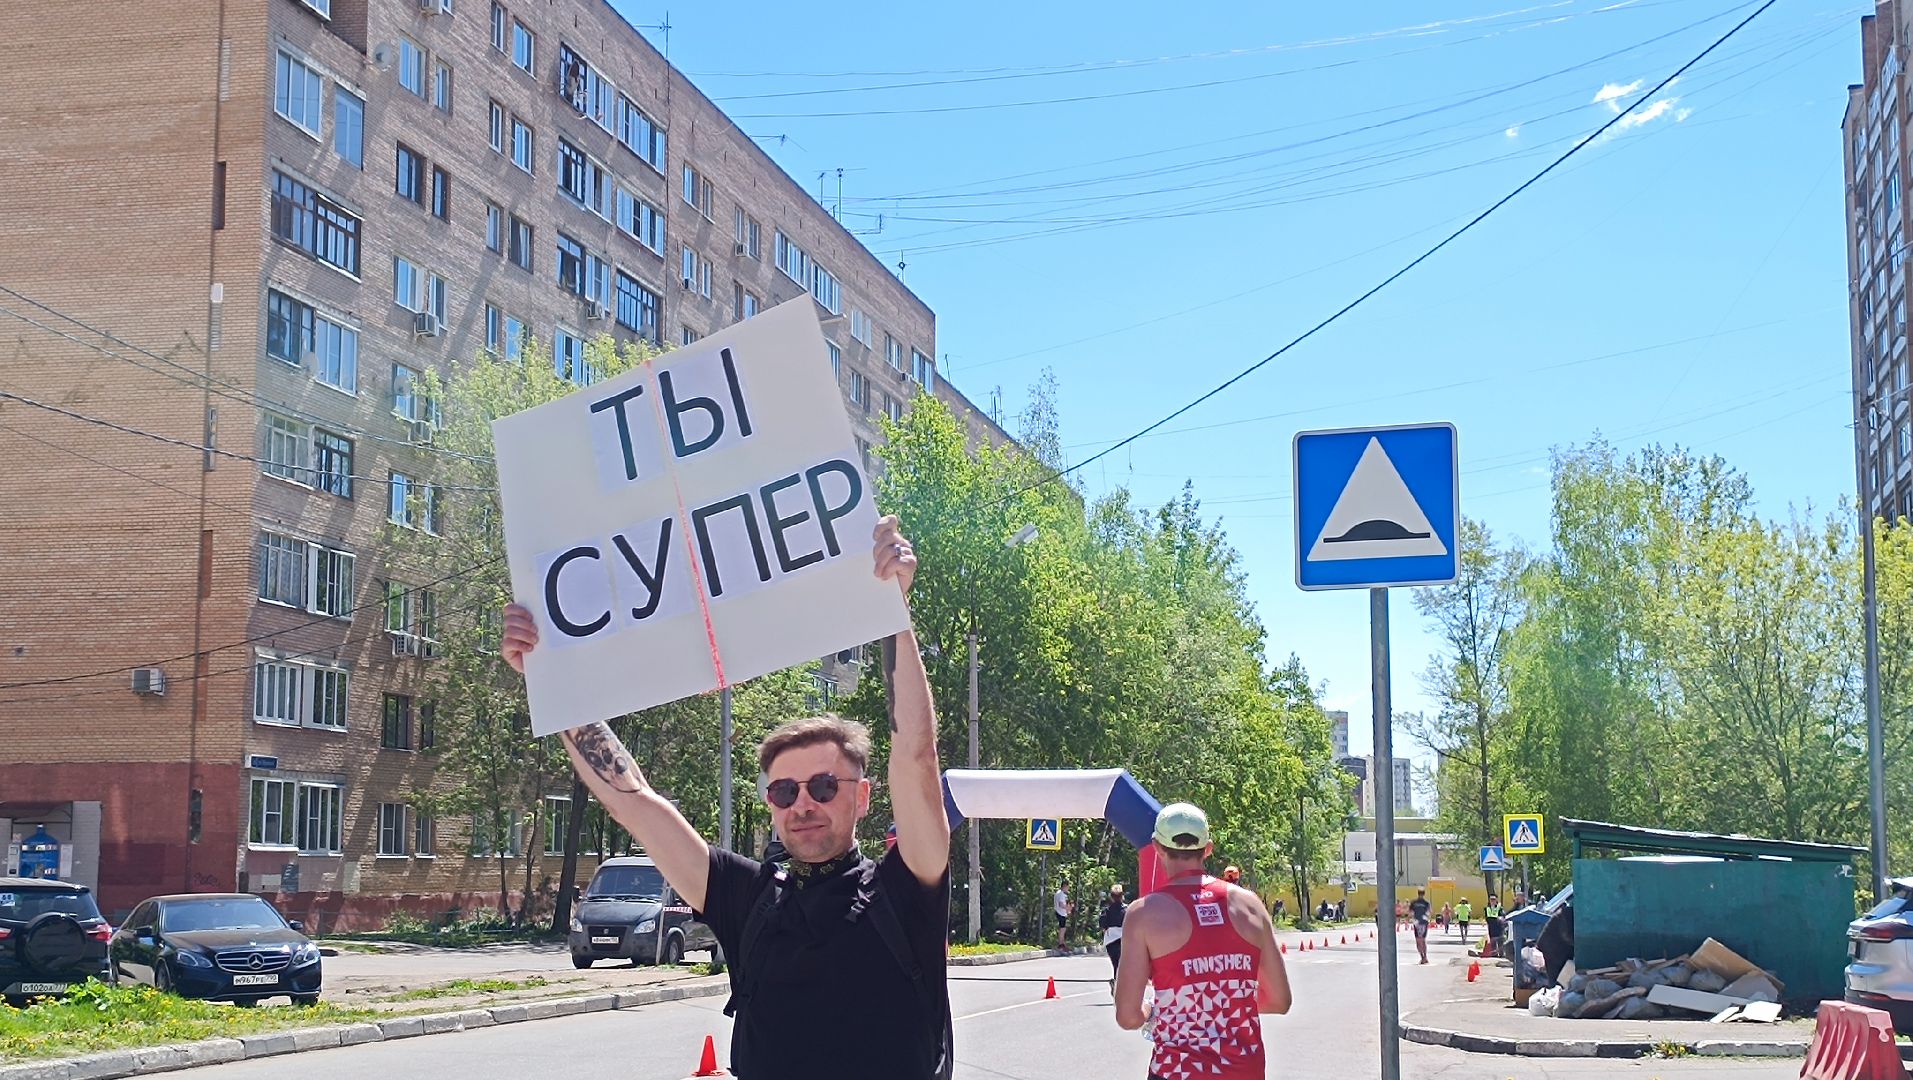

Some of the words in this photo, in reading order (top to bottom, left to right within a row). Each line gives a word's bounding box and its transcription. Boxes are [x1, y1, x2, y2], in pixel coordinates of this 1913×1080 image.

[589, 346, 753, 481] ТЫ
[544, 458, 863, 638] СУПЕР
[1181, 953, 1252, 977] FINISHER
